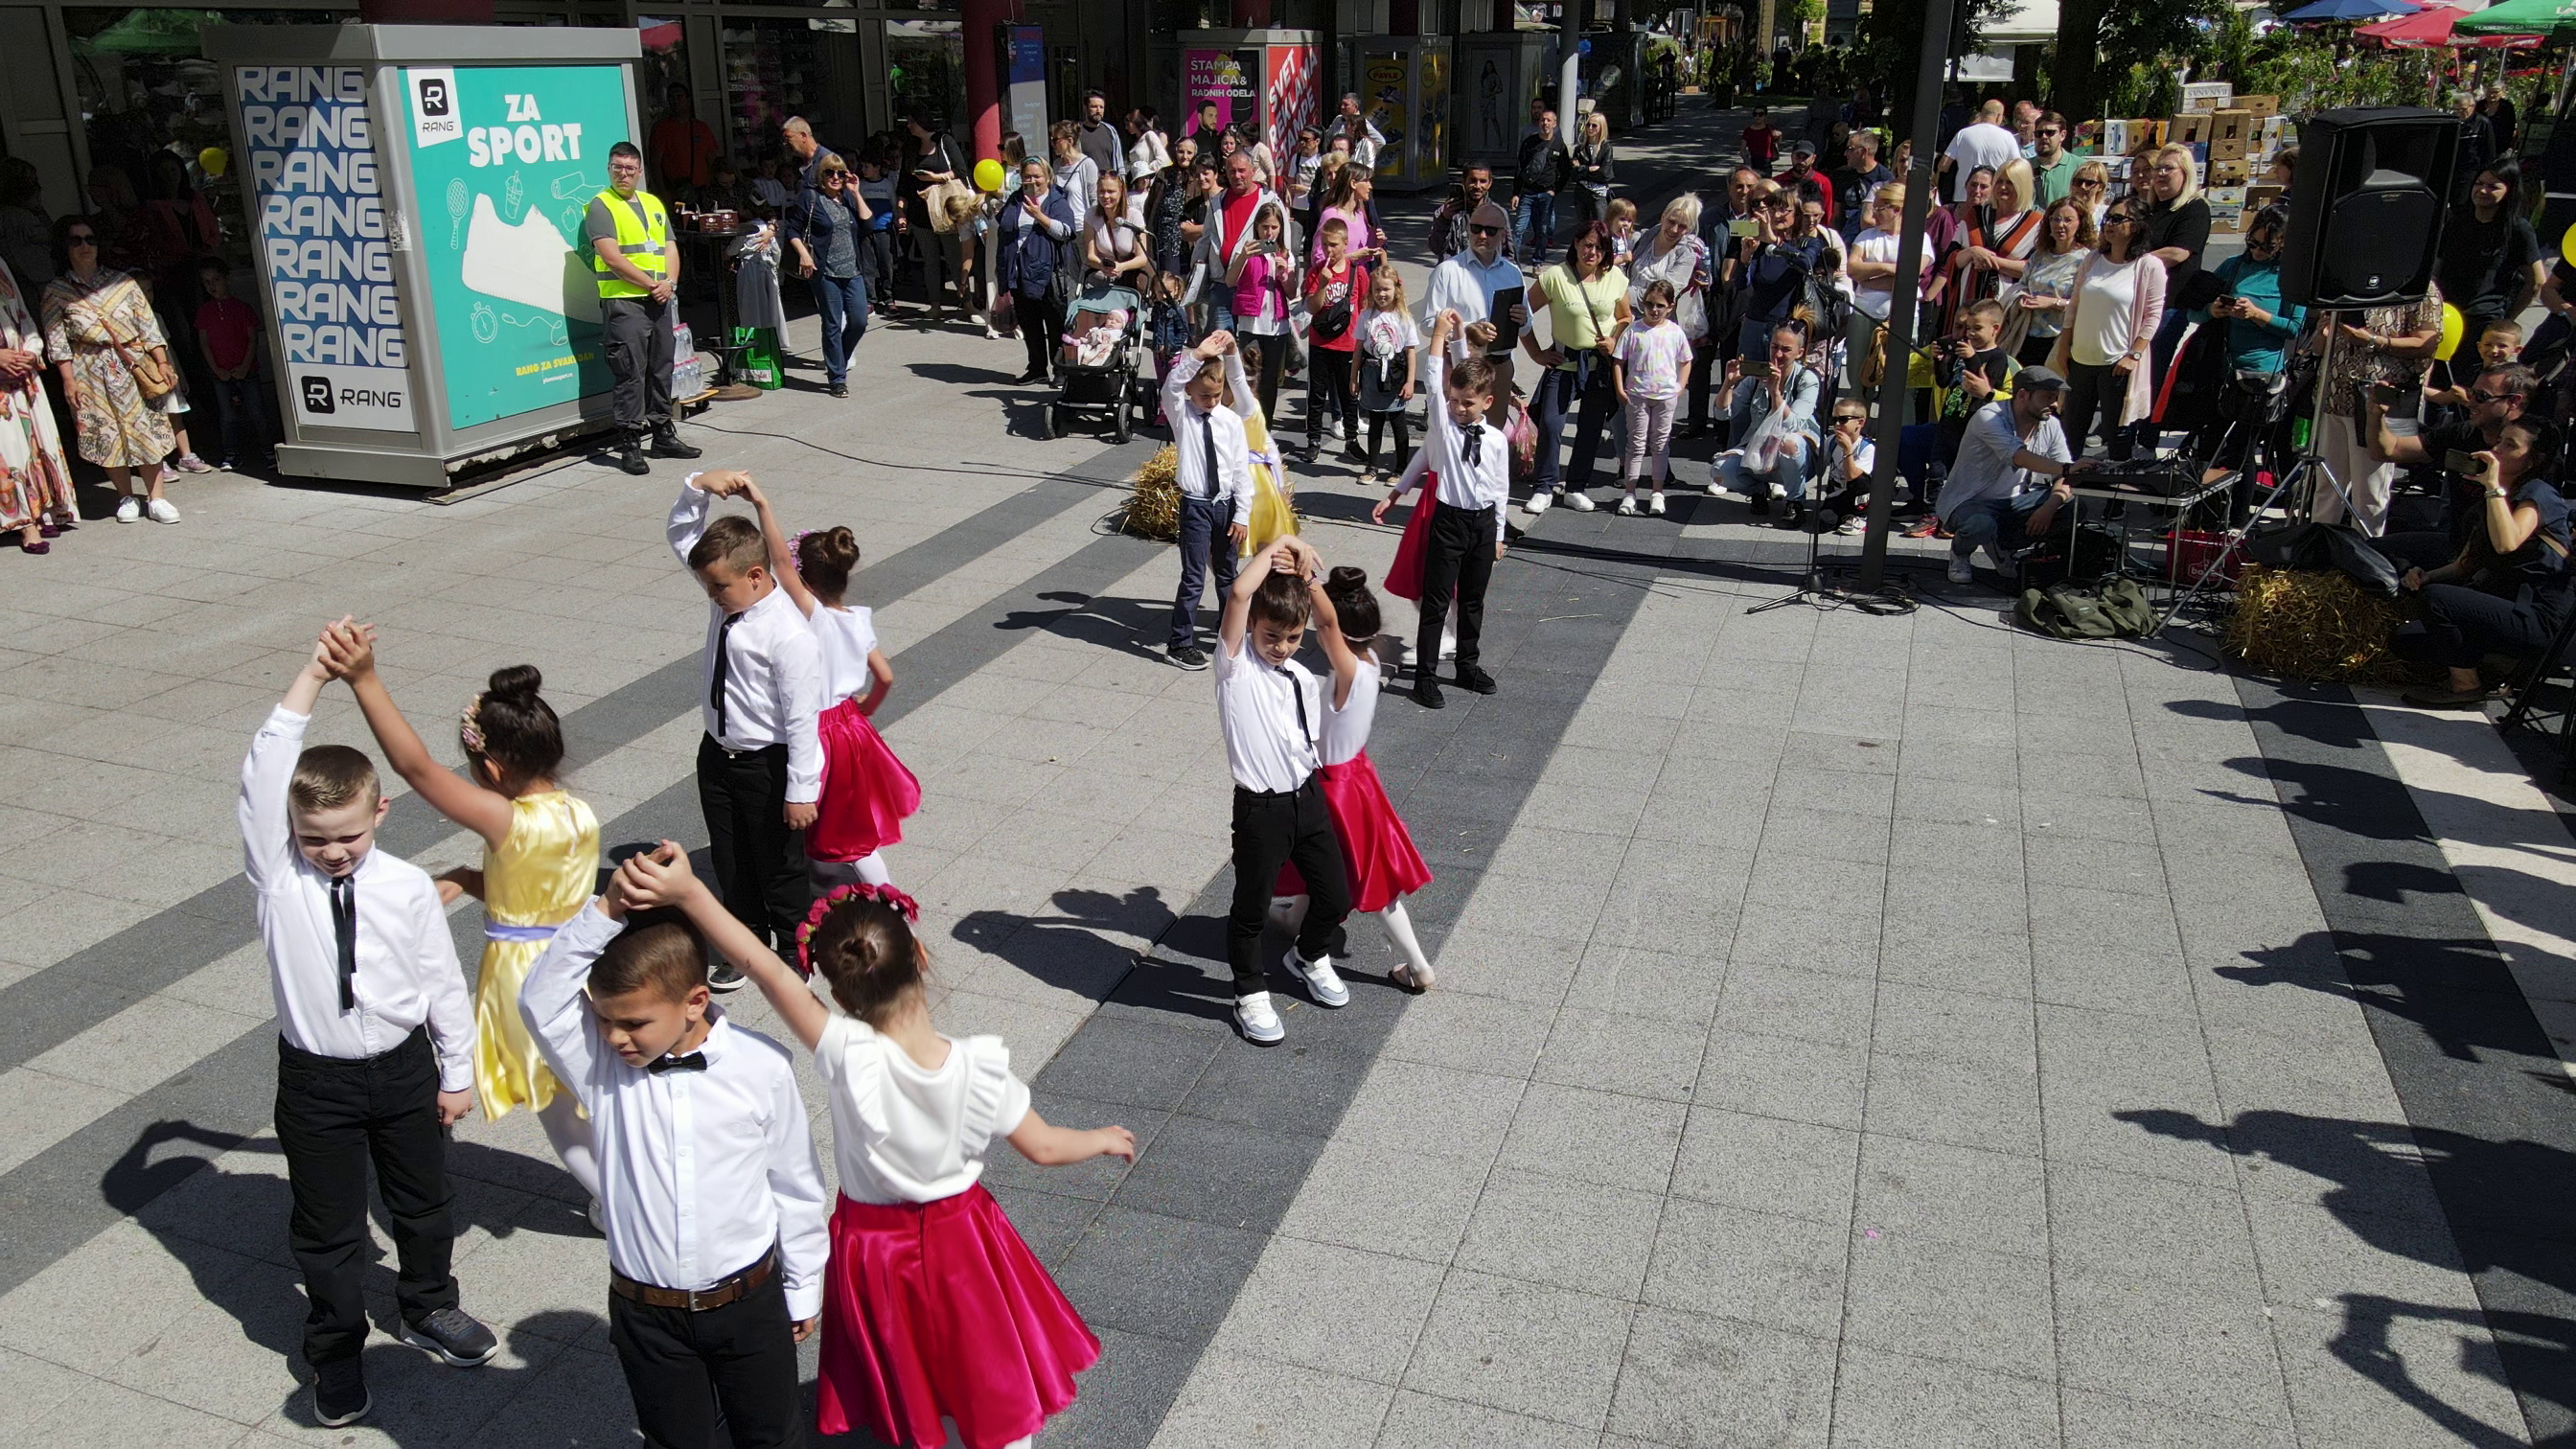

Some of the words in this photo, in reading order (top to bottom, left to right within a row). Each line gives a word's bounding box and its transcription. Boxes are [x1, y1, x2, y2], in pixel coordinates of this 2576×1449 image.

[1190, 58, 1241, 71] ŠTAMPA
[1190, 74, 1239, 85] MAJICA
[1239, 76, 1248, 85] &
[1269, 48, 1295, 112] SVET
[236, 67, 365, 103] RANG
[1191, 88, 1225, 97] RADNIH
[1226, 88, 1256, 97] ODELA
[244, 105, 373, 149] RANG
[422, 121, 454, 132] RANG
[504, 94, 541, 122] ZA
[468, 123, 582, 168] SPORT
[252, 150, 381, 194] RANG
[261, 195, 387, 238] RANG
[267, 239, 395, 282] RANG
[275, 281, 402, 325] RANG
[283, 323, 409, 368] RANG
[516, 363, 540, 376] RANG
[540, 360, 553, 371] ZA
[578, 352, 594, 362] DAN
[340, 388, 402, 408] RANG
